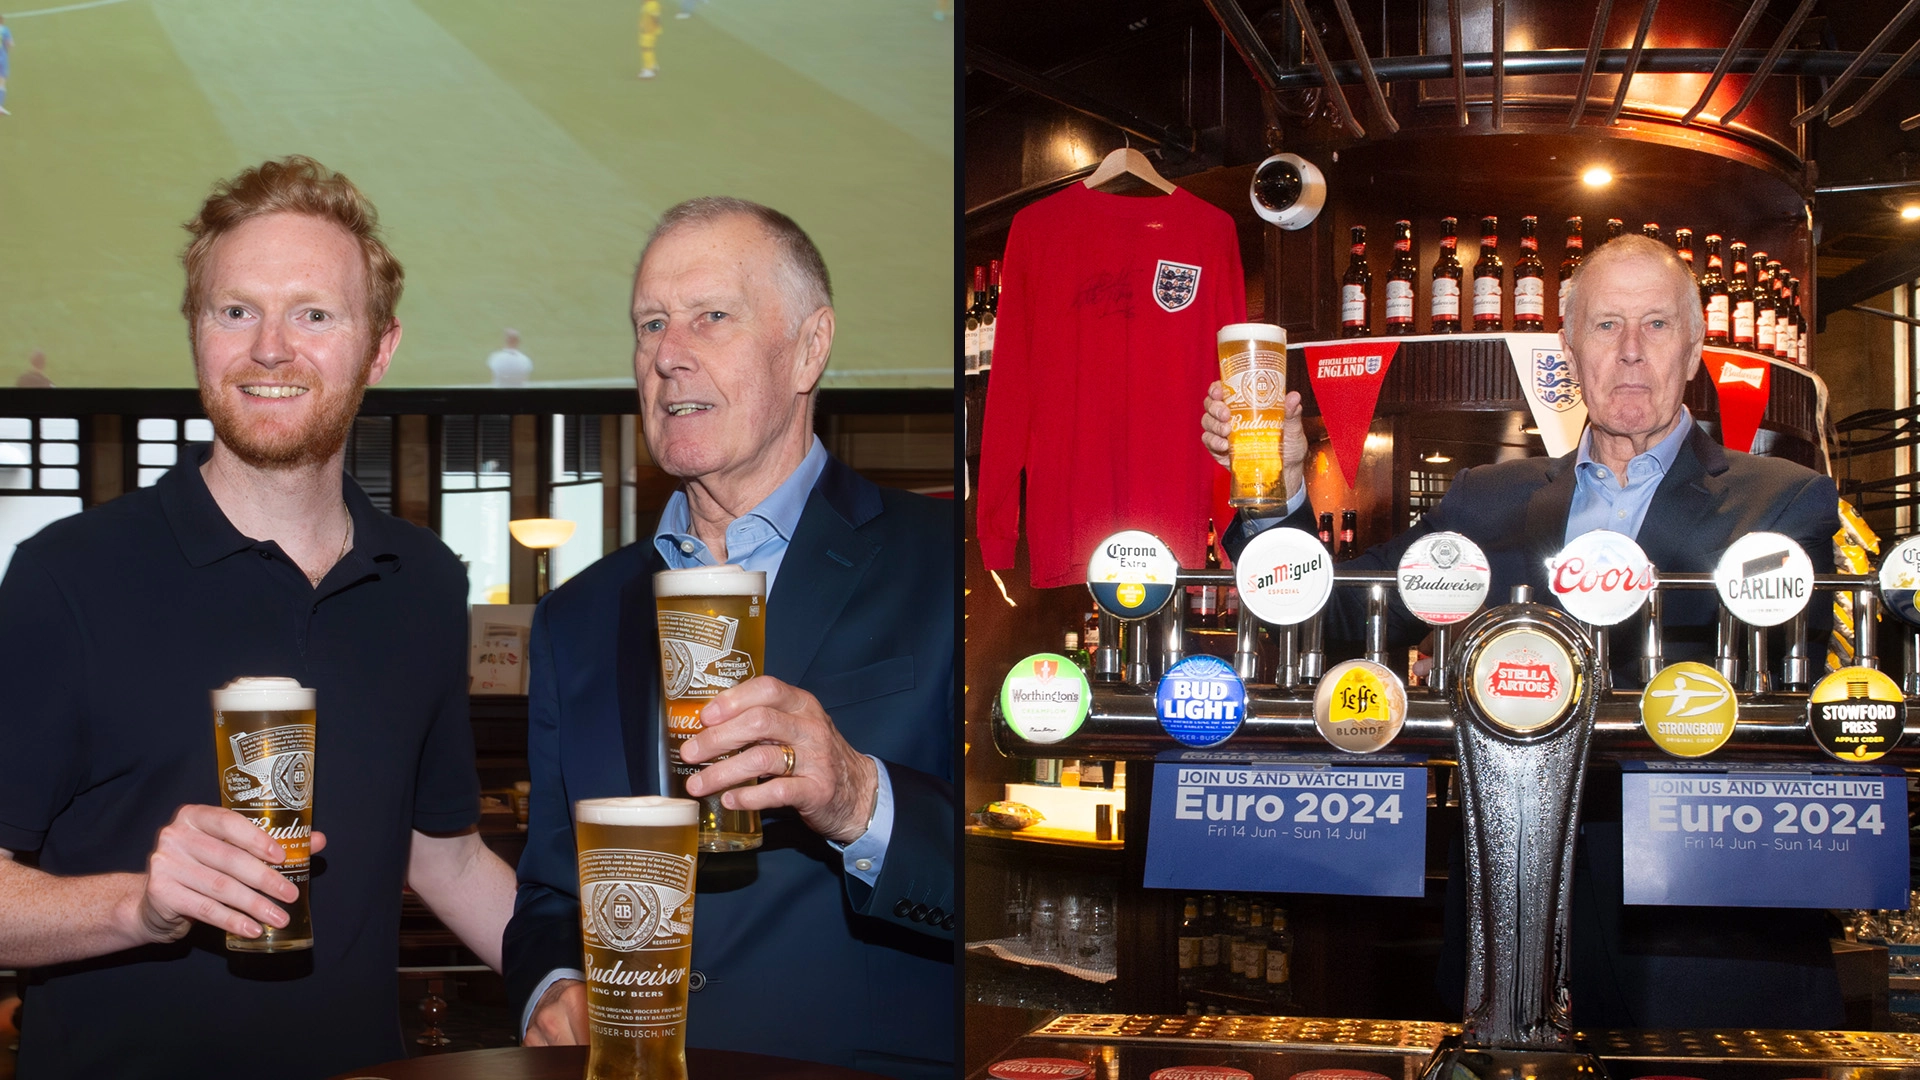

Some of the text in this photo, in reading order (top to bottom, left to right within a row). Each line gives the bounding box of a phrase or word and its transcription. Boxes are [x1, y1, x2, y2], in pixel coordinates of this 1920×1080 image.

[1318, 357, 1342, 366] OFFICIAL
[1343, 356, 1357, 364] BEER
[1317, 364, 1365, 379] ENGLAND
[1107, 543, 1157, 559] Corona
[1120, 557, 1147, 568] Extra
[1402, 574, 1485, 591] Budweiser
[1553, 557, 1654, 594] Coors
[1729, 577, 1804, 600] CARLING
[1498, 668, 1550, 680] STELLA
[1173, 681, 1228, 700] BUD
[1497, 680, 1551, 693] ARTOIS
[1012, 689, 1079, 703] Worthington's
[1340, 685, 1378, 714] Leffe
[1822, 704, 1896, 720] STOWFORD
[1336, 727, 1384, 736] BLONDE
[1657, 722, 1725, 736] STRONGBOW
[1841, 721, 1877, 734] PRESS
[1180, 771, 1403, 788] JOIN US AND WATCH LIVE
[1651, 780, 1882, 797] JOIN US AND WATCH LIVE
[1175, 786, 1403, 825] Euro 2024
[1650, 797, 1885, 836] Euro 2024
[1207, 825, 1227, 837] Fri
[1232, 825, 1246, 837] 14
[1250, 827, 1277, 839] Jun
[1294, 827, 1321, 840] Sun
[1326, 828, 1340, 840] 14
[1345, 828, 1366, 841] Jul
[1684, 836, 1704, 849] Fri
[1709, 837, 1724, 849] 14
[1729, 838, 1756, 850] Jun
[1774, 838, 1802, 851] Sun
[1807, 838, 1822, 851] 14
[1827, 839, 1849, 852] Jul
[591, 986, 610, 995] KING
[606, 1006, 632, 1014] ORIGINAL
